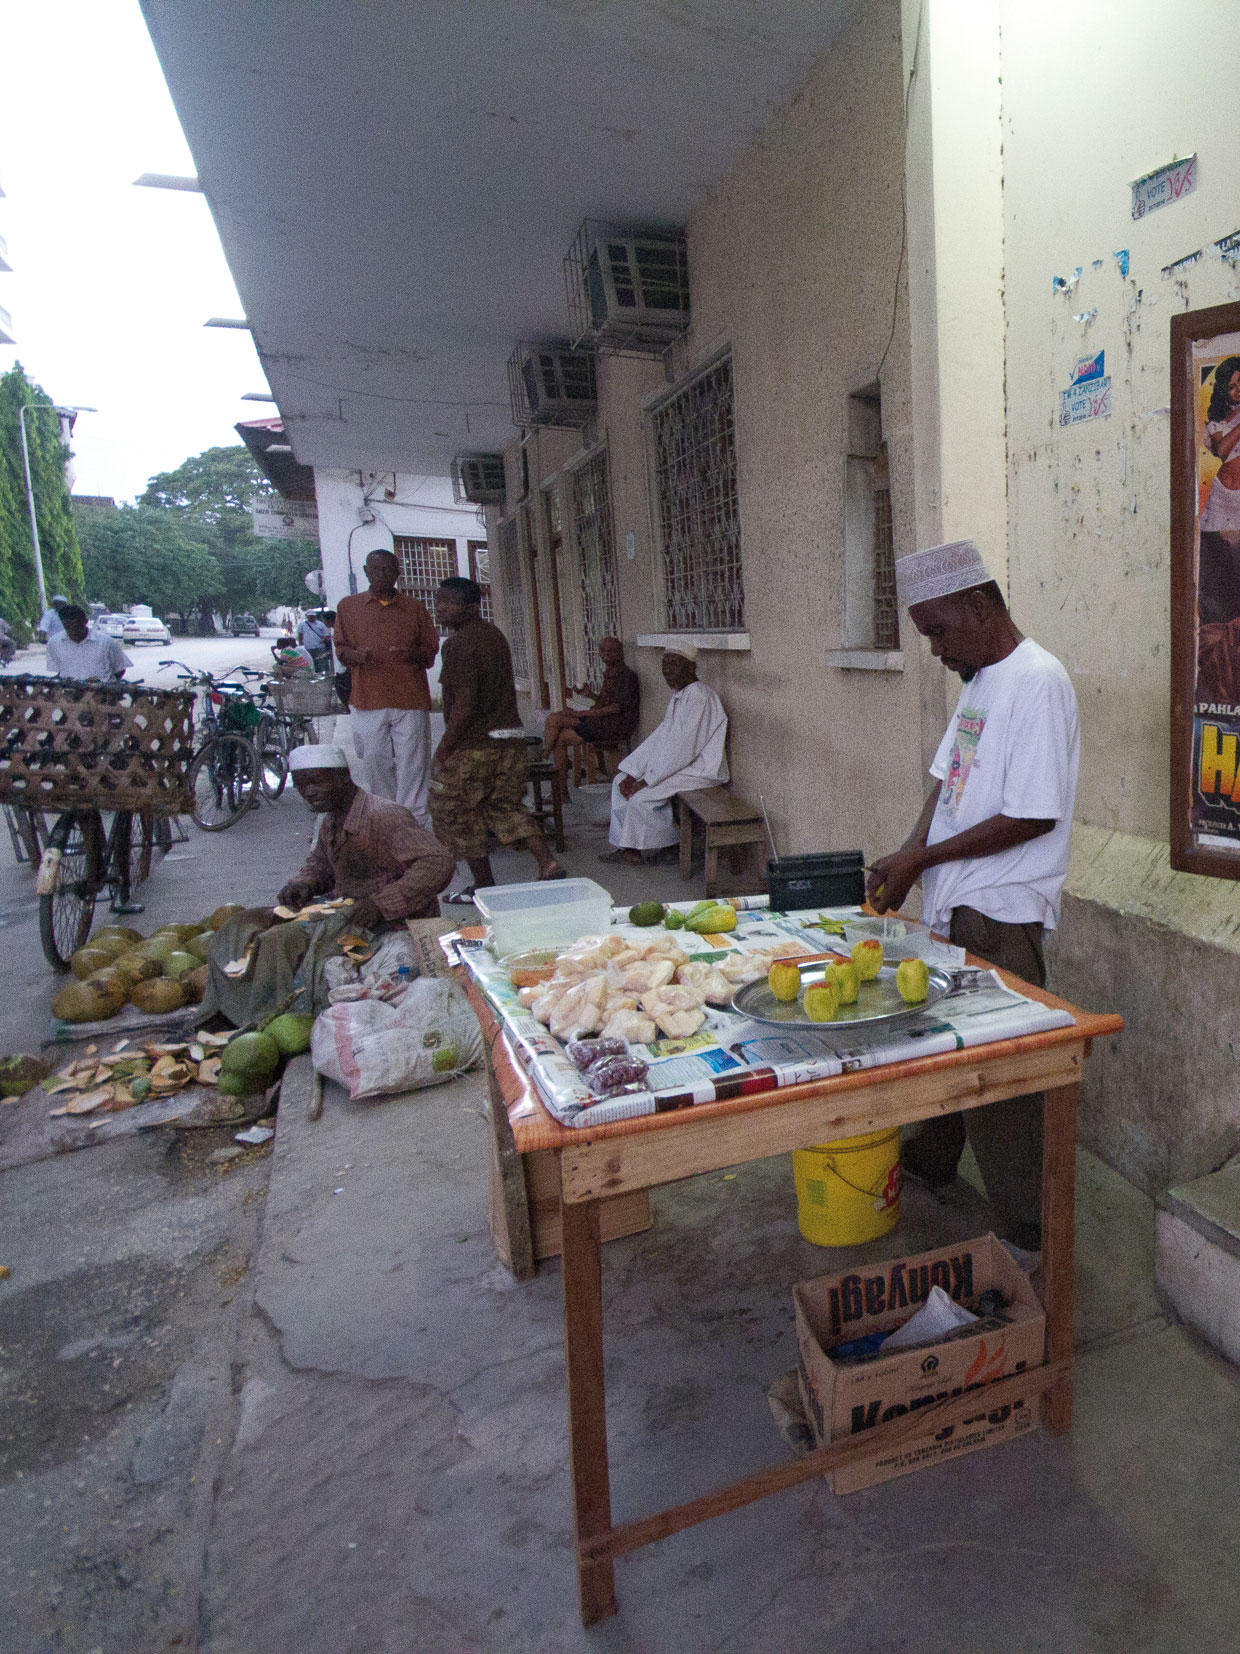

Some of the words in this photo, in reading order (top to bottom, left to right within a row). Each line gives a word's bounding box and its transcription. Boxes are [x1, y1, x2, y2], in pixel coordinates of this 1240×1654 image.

[1147, 181, 1166, 199] VOTE
[1071, 399, 1086, 412] VOTE
[829, 1253, 973, 1336] Konyagi
